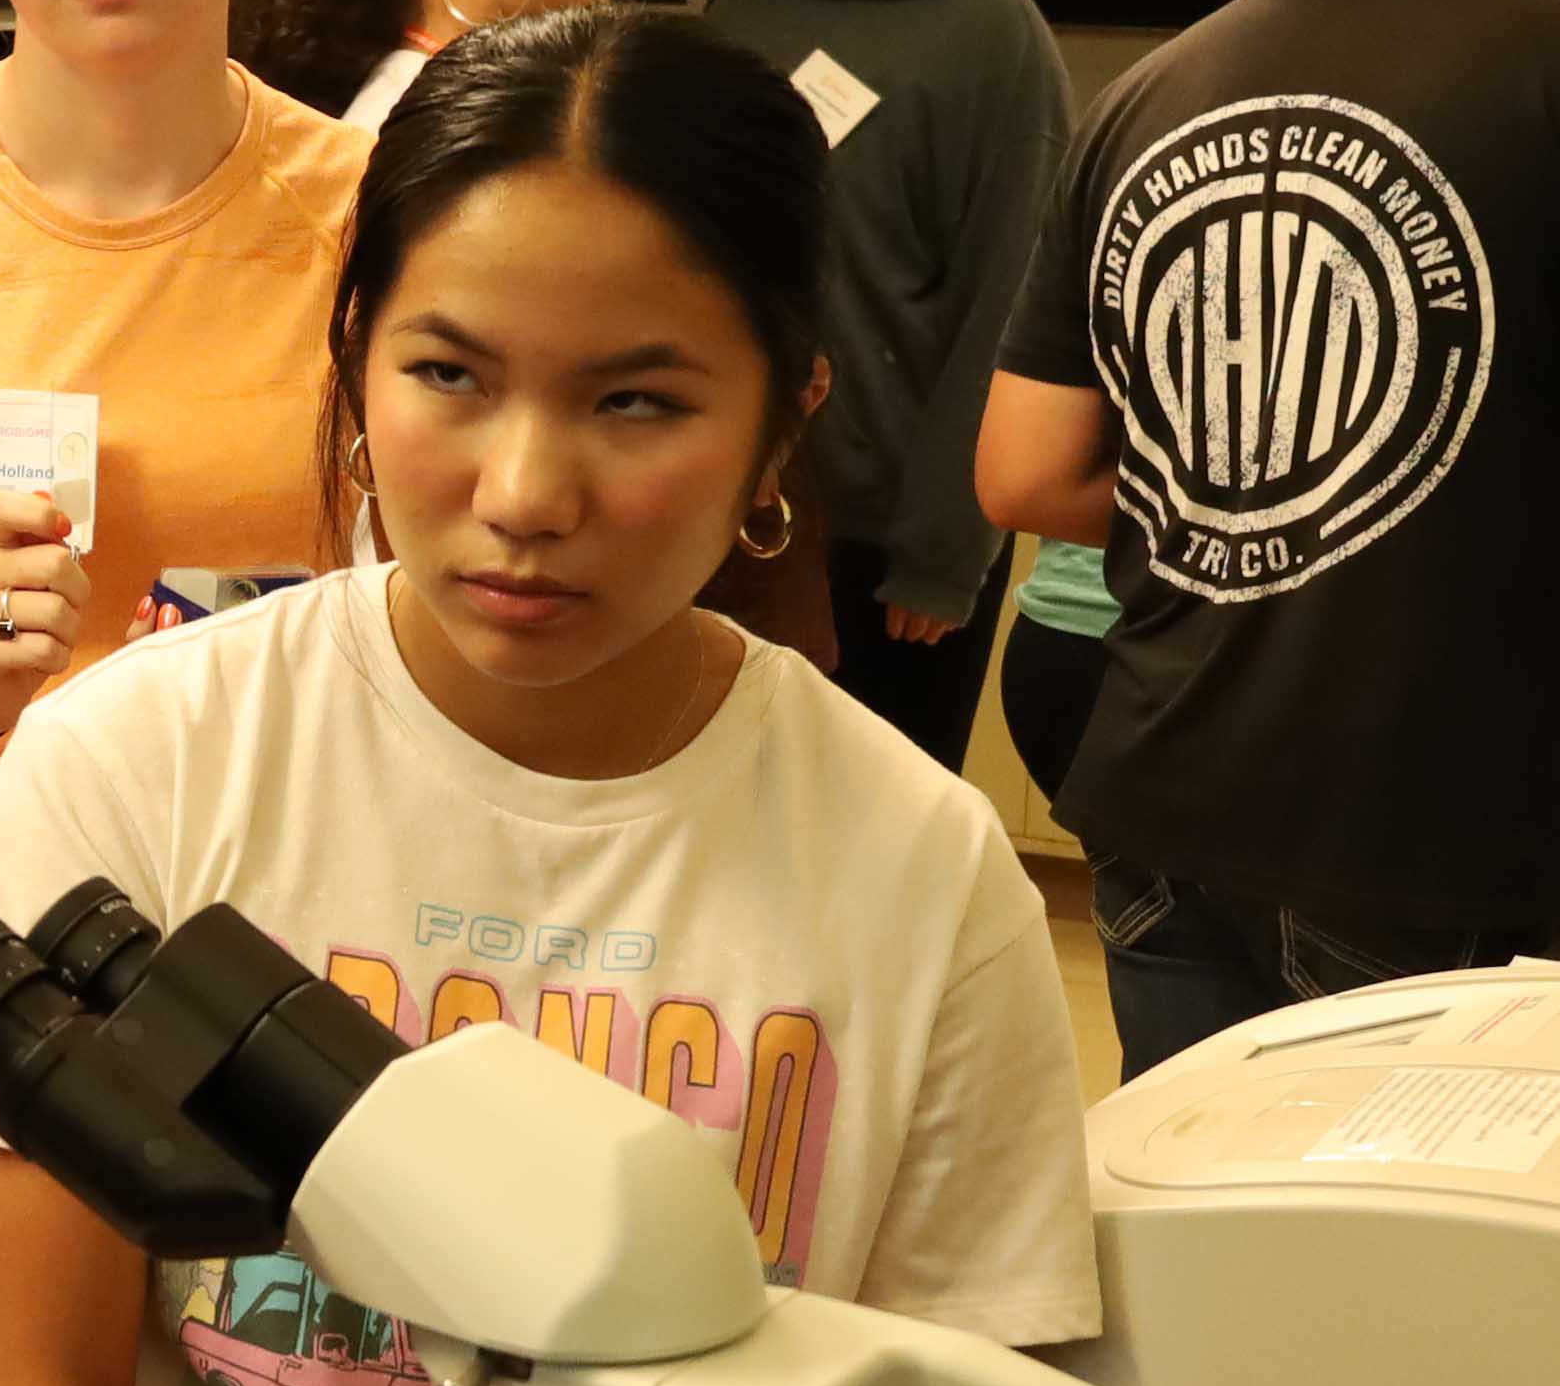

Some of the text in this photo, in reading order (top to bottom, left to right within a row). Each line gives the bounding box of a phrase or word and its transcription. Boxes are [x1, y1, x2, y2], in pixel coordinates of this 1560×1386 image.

[1103, 125, 1468, 312] DIRTY HANDS CLEAN MONEY
[1240, 536, 1304, 578] CO.
[415, 903, 657, 972] FORD
